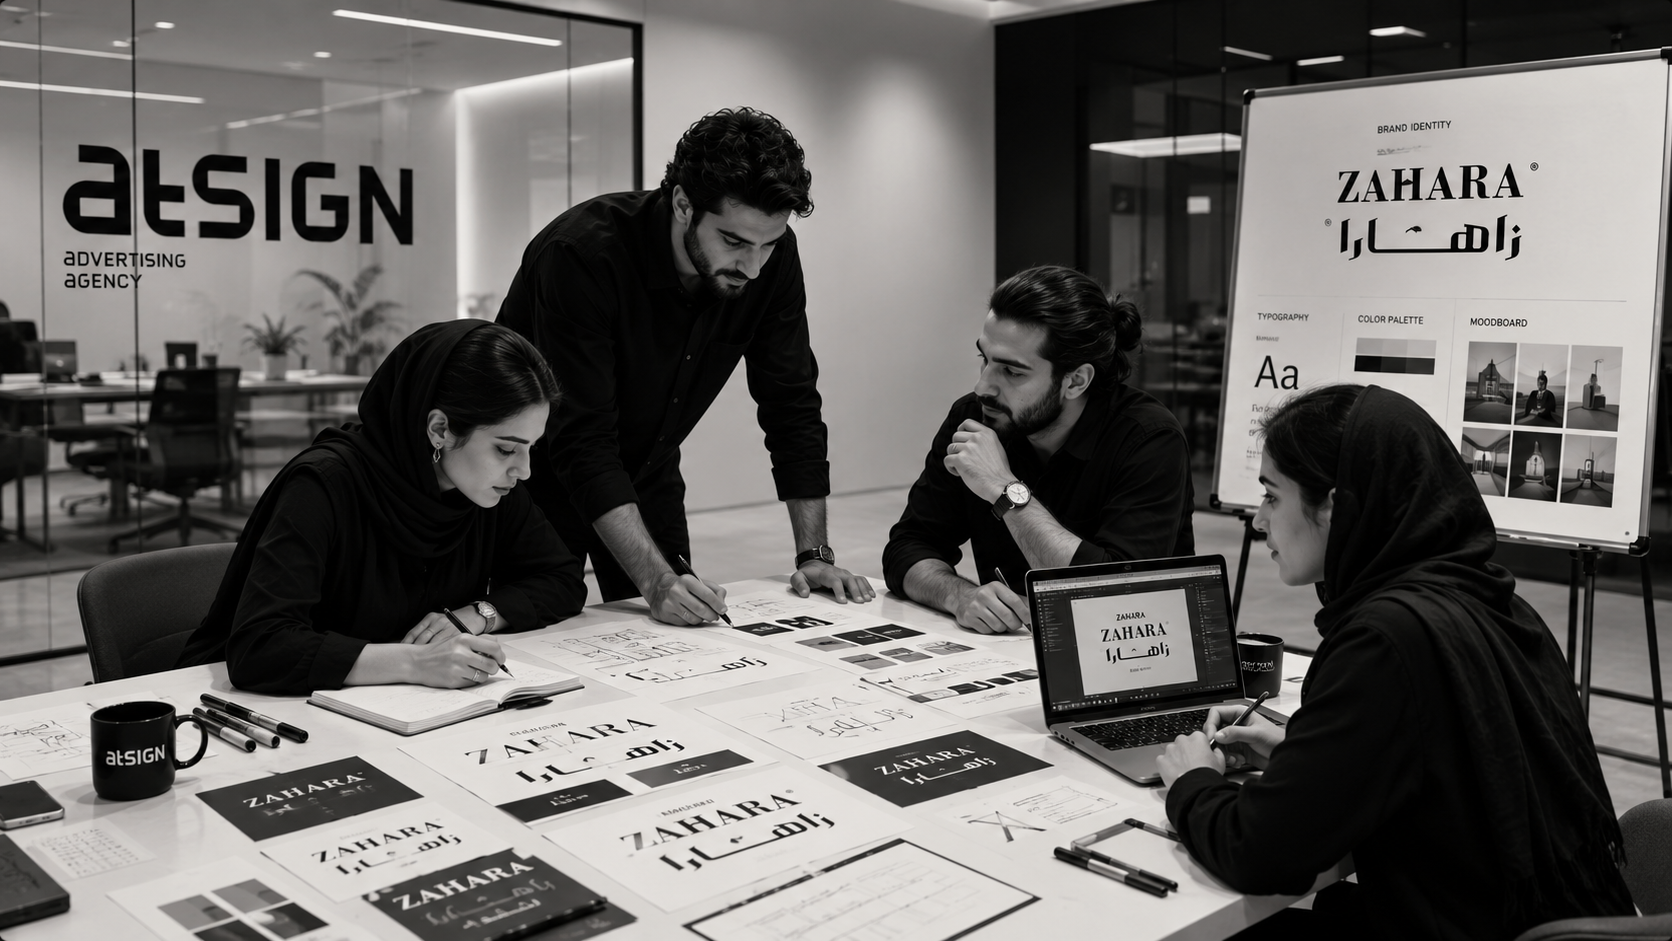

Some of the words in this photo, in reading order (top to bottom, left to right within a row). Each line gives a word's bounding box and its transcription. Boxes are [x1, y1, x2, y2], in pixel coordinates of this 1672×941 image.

[1376, 123, 1408, 135] BRAND
[1410, 119, 1452, 132] IDENTITY
[1337, 162, 1524, 204] ZAHARA
[1257, 312, 1310, 322] TYPOGRAPHY
[1357, 314, 1387, 325] COLOR
[1387, 315, 1424, 325] PALETTE
[1469, 317, 1528, 328] MOODBOARD
[1254, 355, 1299, 390] Aa
[1100, 622, 1167, 643] ZAHARA
[873, 745, 976, 777] ZAHARA
[242, 772, 367, 809] ZAHARA
[311, 820, 445, 863] ZAHARA
[392, 861, 535, 911] ZAHARA
